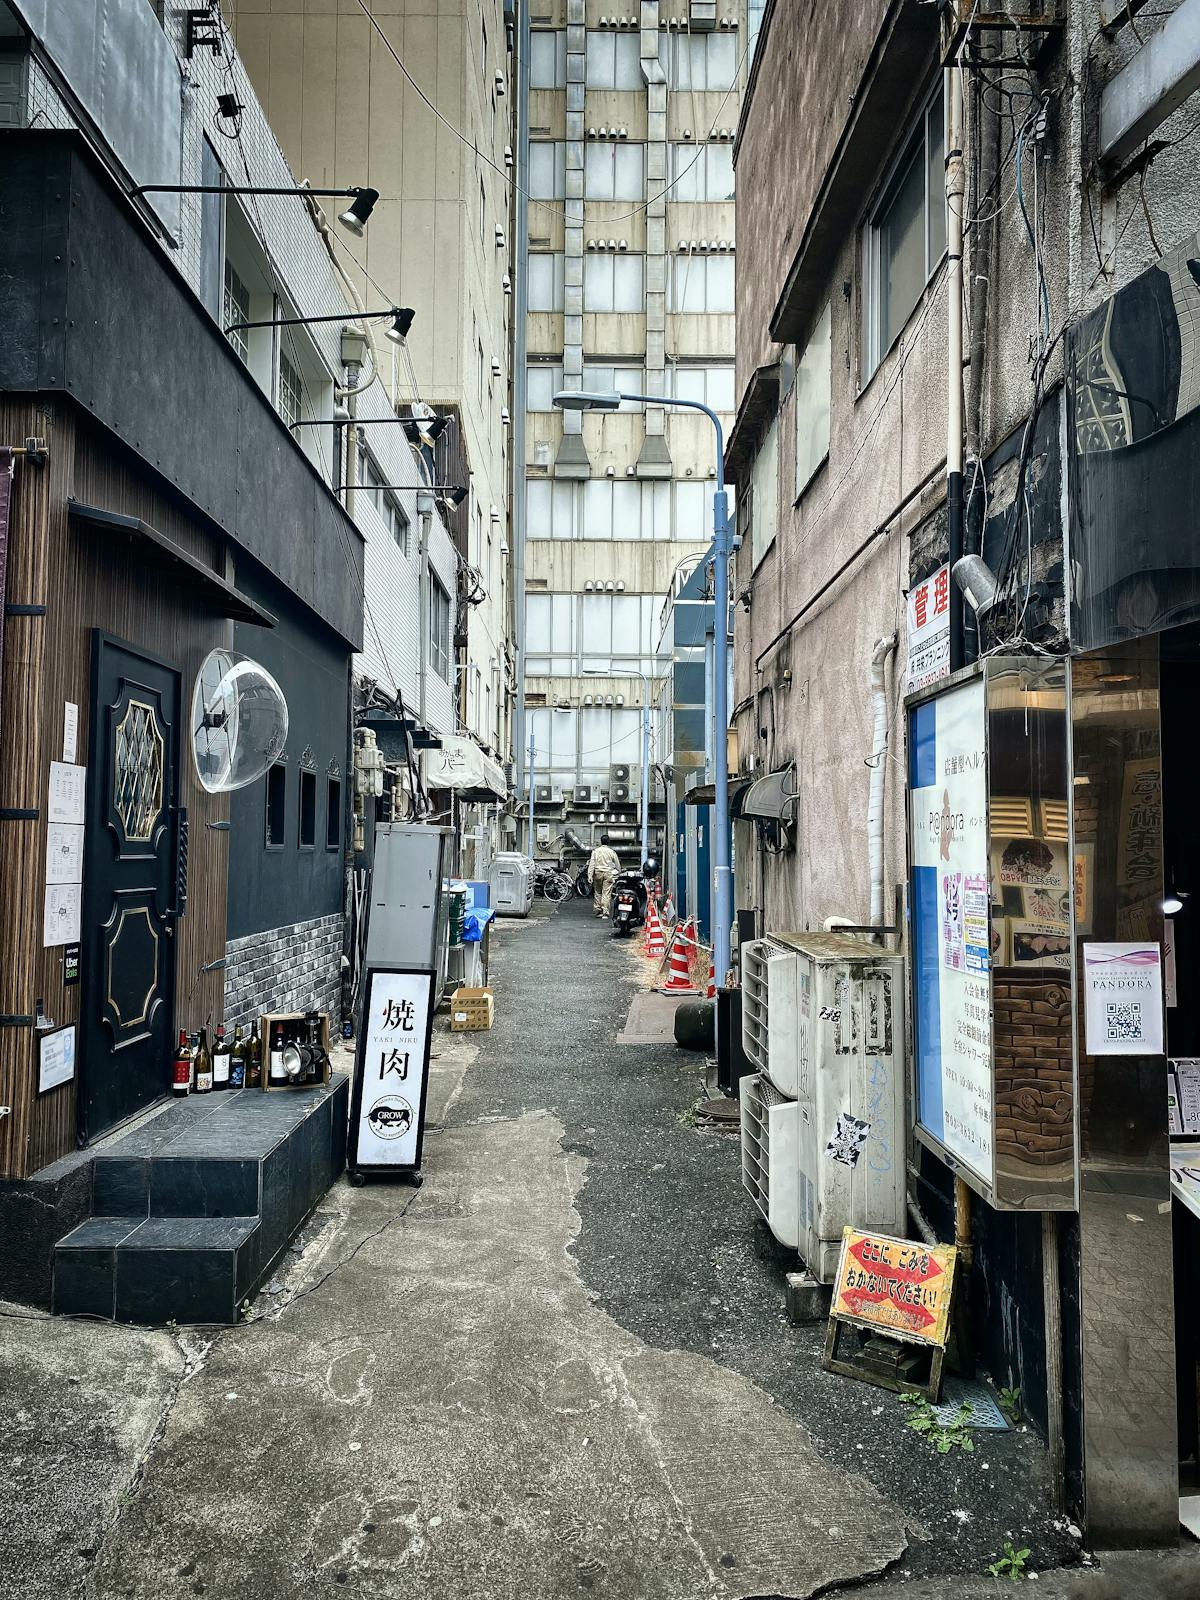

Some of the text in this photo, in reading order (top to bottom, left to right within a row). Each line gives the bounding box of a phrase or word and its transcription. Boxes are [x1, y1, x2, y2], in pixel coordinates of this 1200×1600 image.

[914, 568, 948, 628] 管理
[65, 957, 78, 969] Uber
[1093, 980, 1152, 989] PANDORA
[381, 999, 414, 1031] 焼
[379, 1048, 410, 1081] 肉
[377, 1111, 404, 1120] GROW
